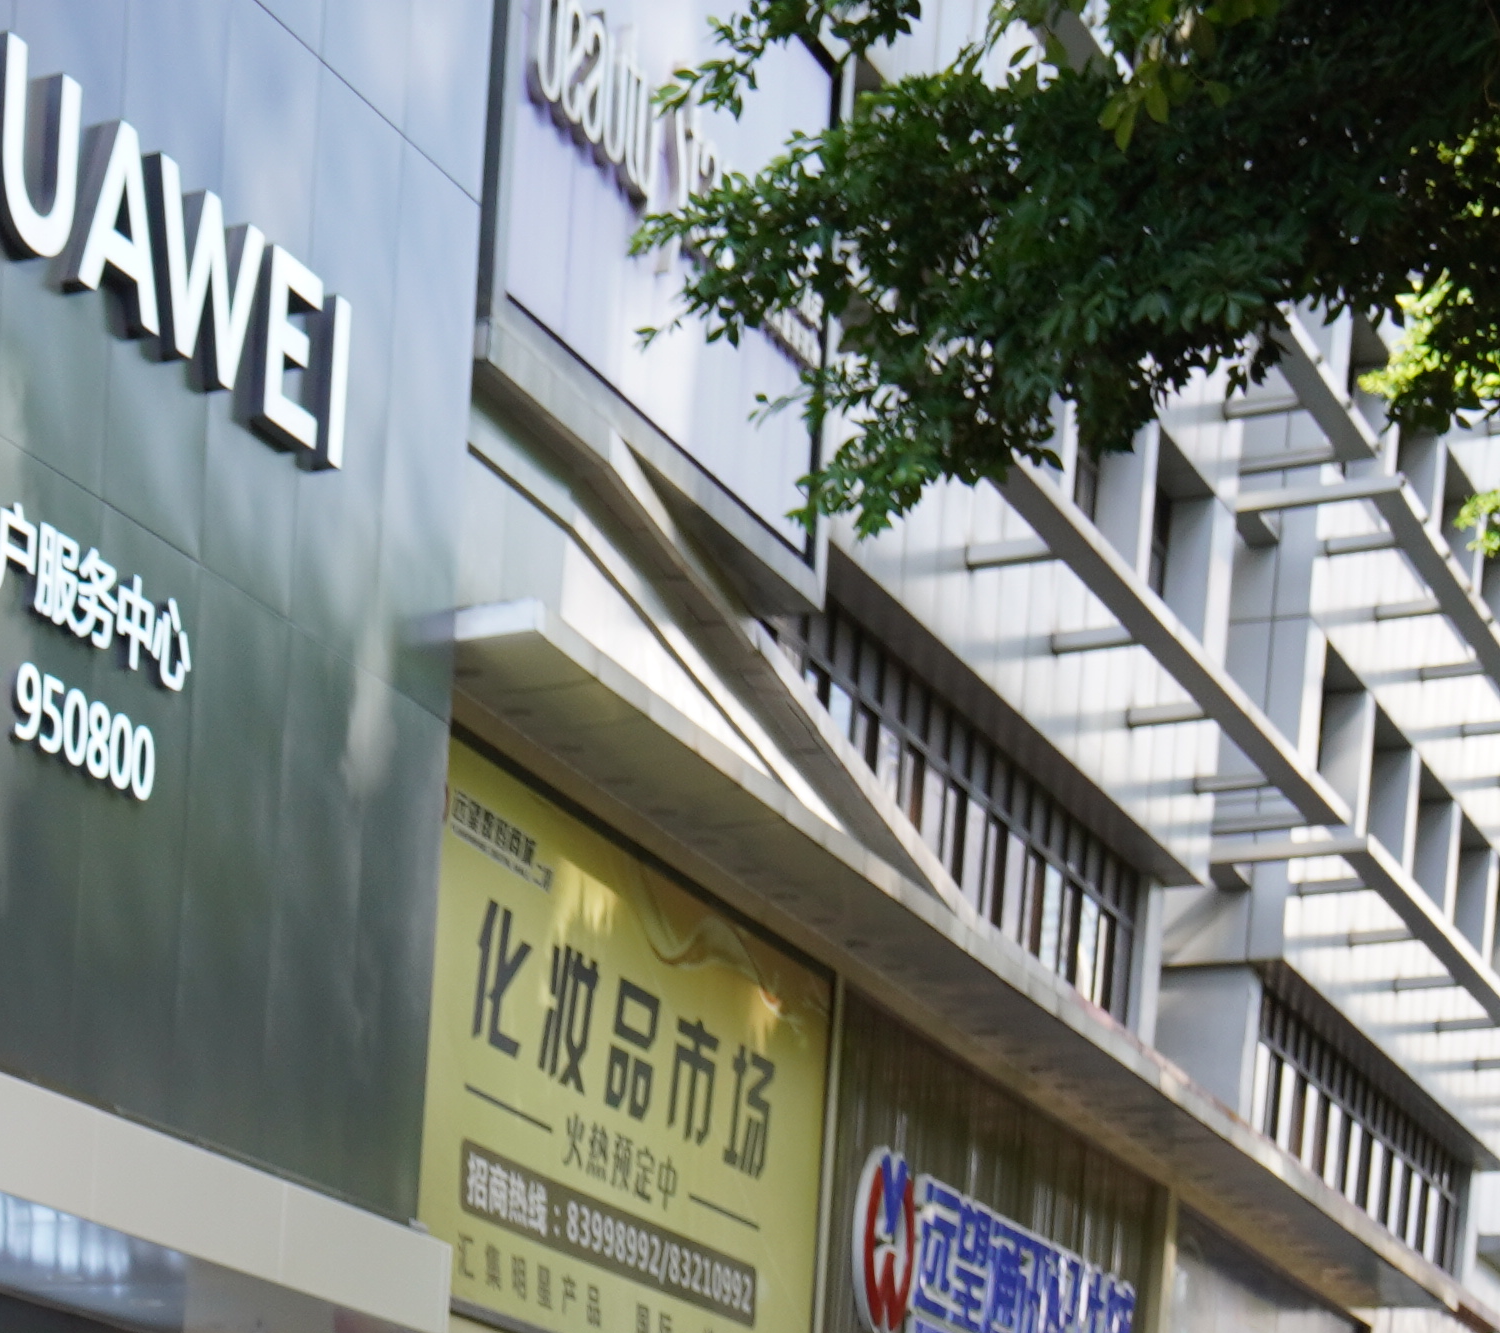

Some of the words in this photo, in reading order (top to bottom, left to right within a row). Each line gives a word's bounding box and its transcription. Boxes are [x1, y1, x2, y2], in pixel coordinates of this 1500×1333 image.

[472, 898, 775, 1178] 化妆品市场
